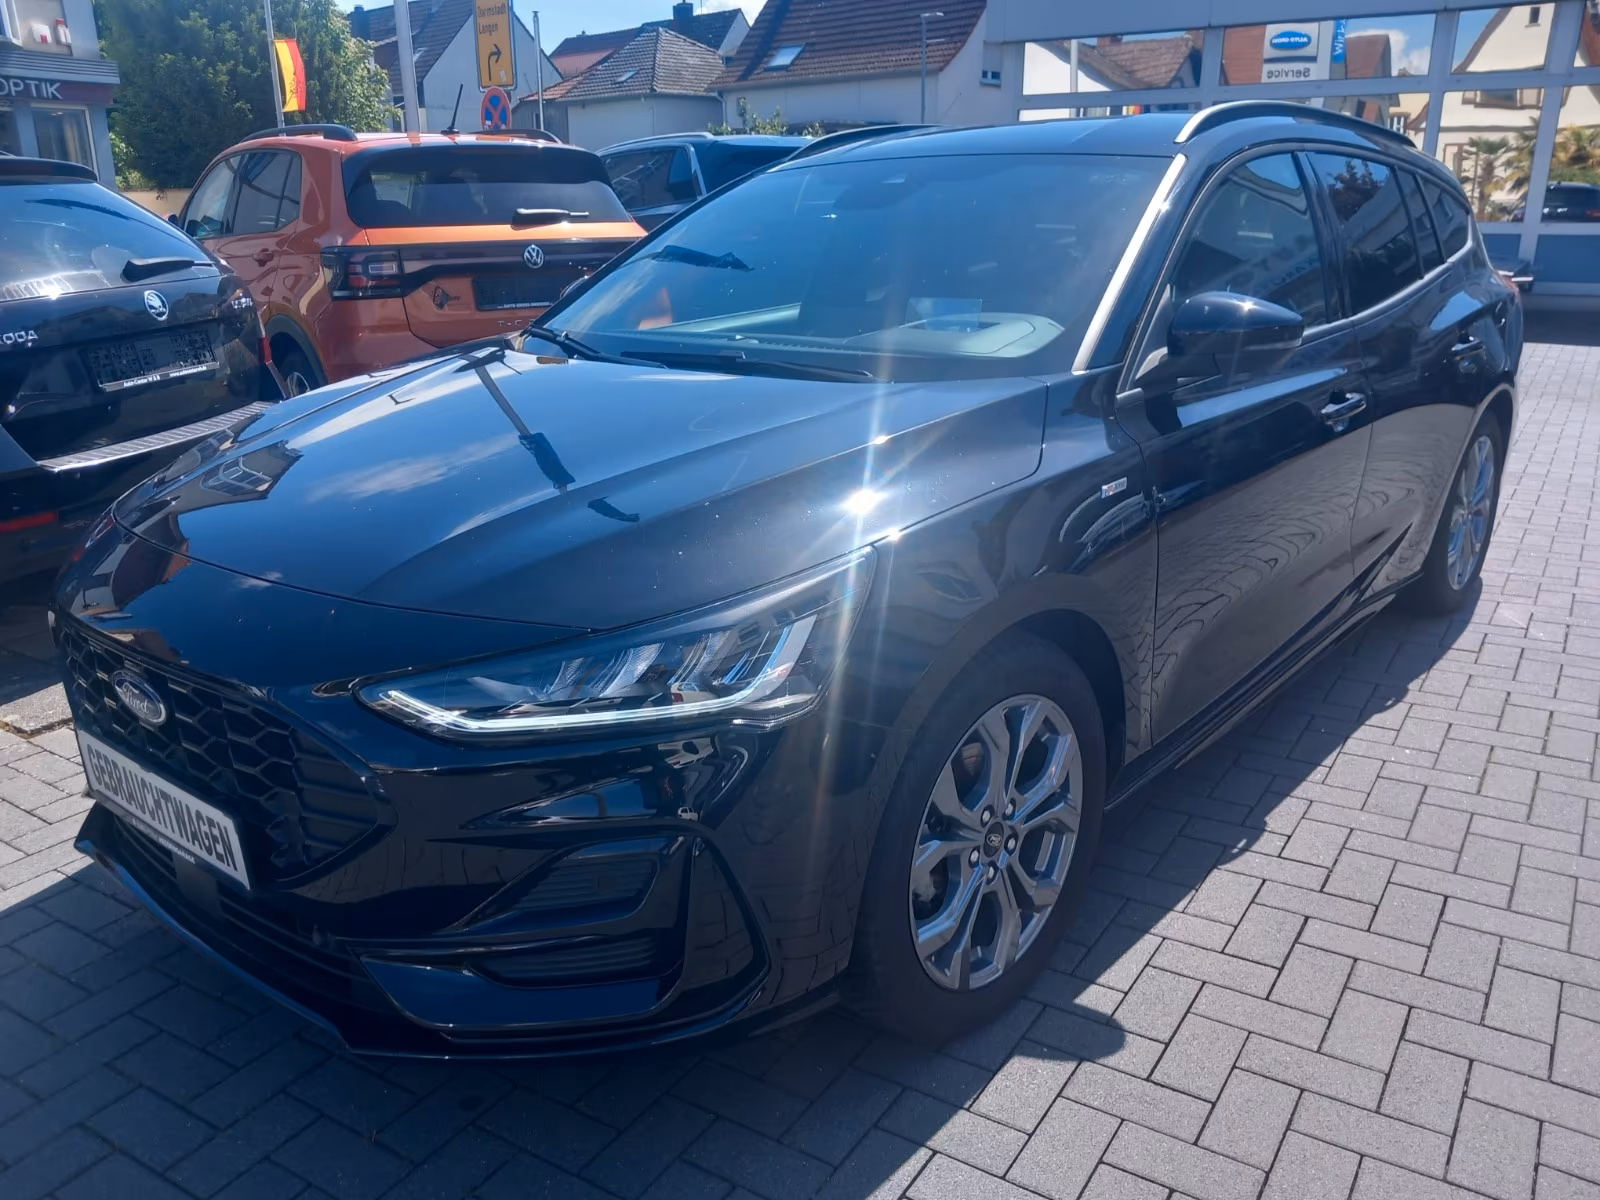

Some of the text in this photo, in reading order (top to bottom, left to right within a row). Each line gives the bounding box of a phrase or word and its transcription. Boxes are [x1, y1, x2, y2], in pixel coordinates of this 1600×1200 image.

[478, 22, 498, 36] Langen
[0, 330, 38, 344] ODA
[120, 682, 150, 714] Ford
[87, 743, 238, 872] GEBRAUCHTWAGEN
